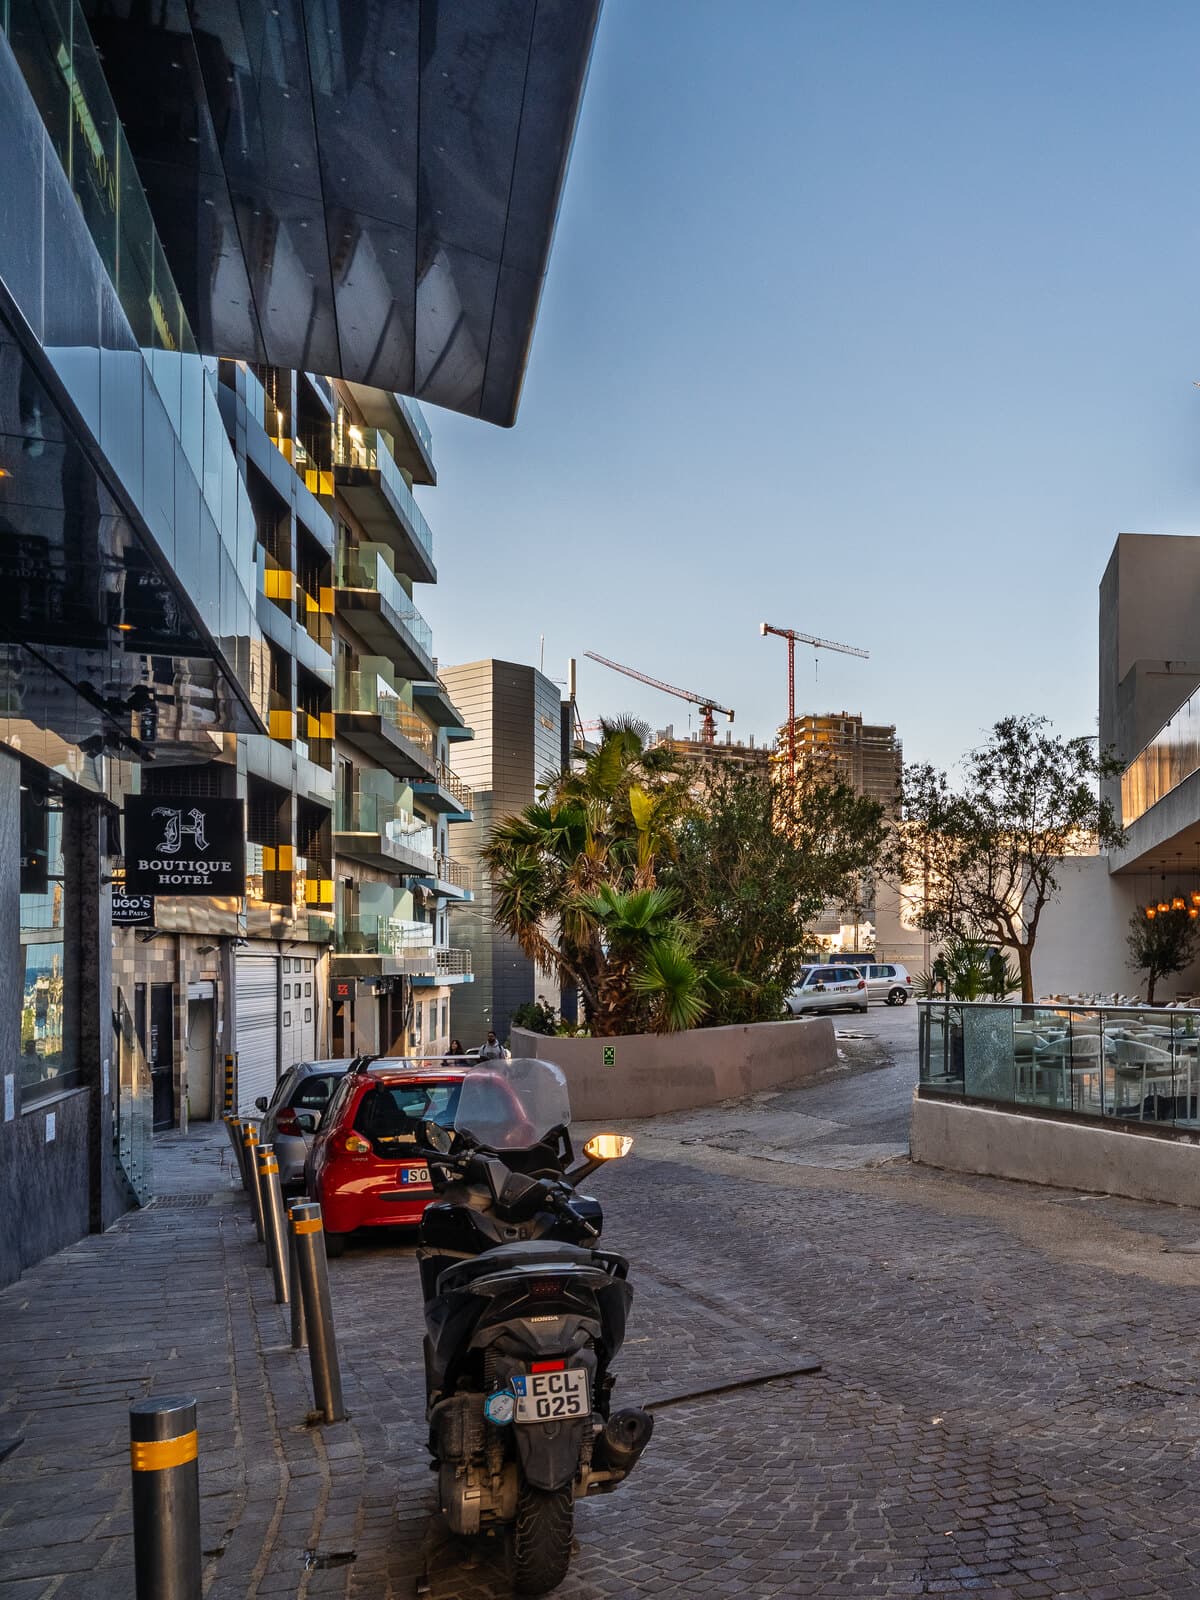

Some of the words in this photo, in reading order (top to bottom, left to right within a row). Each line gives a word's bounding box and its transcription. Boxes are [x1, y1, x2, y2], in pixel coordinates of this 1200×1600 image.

[137, 859, 232, 875] BOUTIQUE
[158, 874, 213, 885] HOTEL
[112, 896, 151, 909] UGO'S
[532, 1373, 579, 1396] ECL
[536, 1395, 580, 1418] 025
